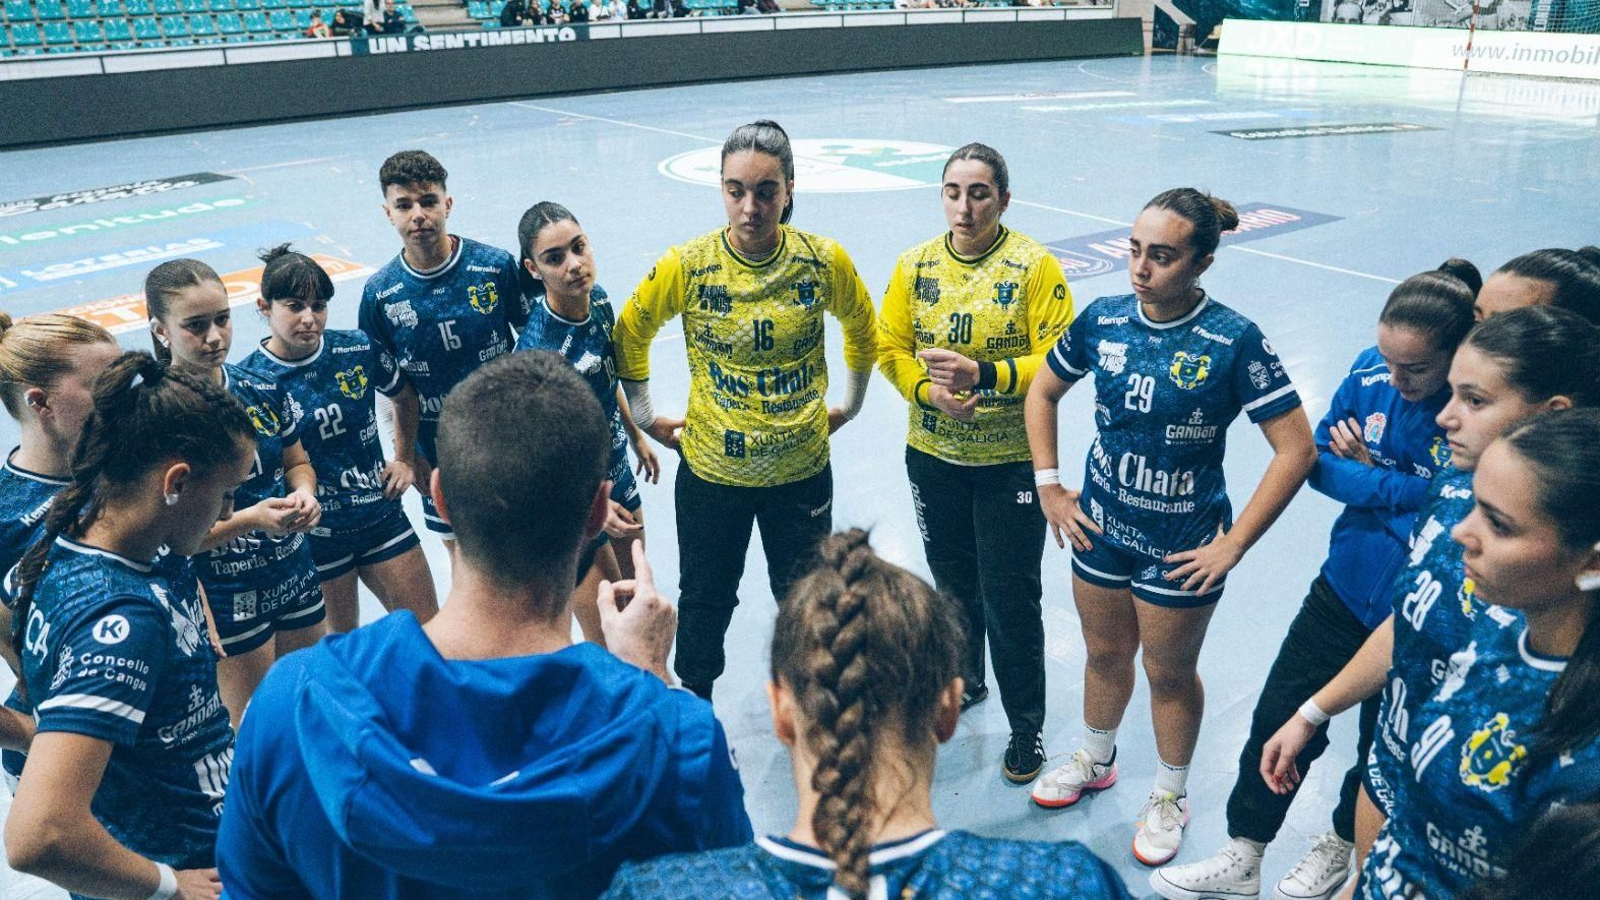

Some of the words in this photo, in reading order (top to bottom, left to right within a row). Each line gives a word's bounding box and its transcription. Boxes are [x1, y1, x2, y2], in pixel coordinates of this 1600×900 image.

[369, 37, 407, 54] UN
[413, 27, 576, 51] SENTIMENTO
[376, 283, 404, 300] Kempa
[948, 312, 973, 345] 30
[1098, 316, 1129, 326] Kempa
[438, 320, 462, 351] 15
[753, 319, 774, 351] 16
[1361, 373, 1392, 387] Kemp
[1125, 373, 1156, 414] 29
[314, 403, 347, 440] 22
[751, 430, 796, 446] XUNTA
[771, 427, 817, 457] GALICIA
[957, 432, 1009, 443] GALICIA
[1118, 452, 1195, 496] Chata
[1017, 491, 1032, 504] 30
[1118, 488, 1195, 513] Restaurante
[262, 574, 299, 600] XUNTA
[261, 600, 278, 613] DE
[1403, 570, 1442, 632] 28
[80, 652, 150, 675] Concello
[77, 668, 98, 678] de
[104, 667, 147, 691] Cangas
